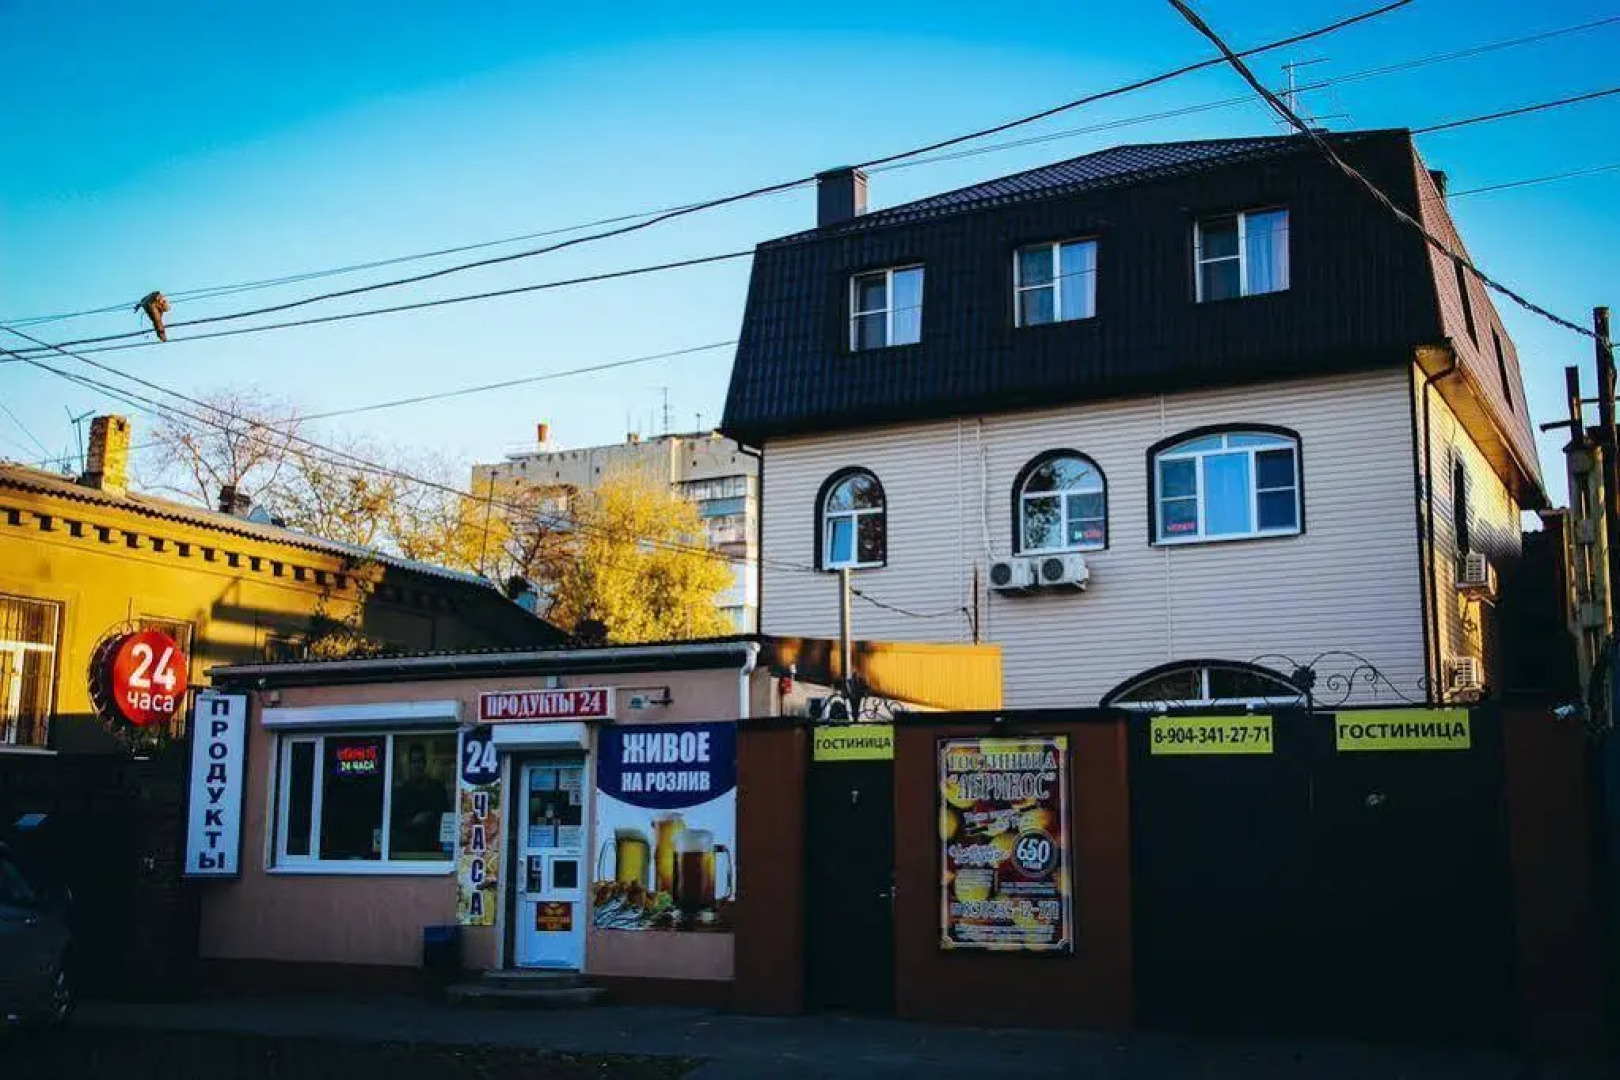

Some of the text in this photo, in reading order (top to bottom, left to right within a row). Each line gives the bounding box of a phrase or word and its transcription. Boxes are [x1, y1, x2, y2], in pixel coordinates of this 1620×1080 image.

[128, 642, 177, 691] 24
[127, 691, 174, 712] часа
[487, 691, 601, 717] ПРОДУКТЫ 24
[816, 736, 892, 750] ГОСТИНИЦА
[1154, 726, 1270, 744] 8-904-341-27-71
[1338, 721, 1466, 741] ГОСТИНИЦА
[466, 740, 498, 774] 24
[622, 731, 711, 764] ЖИВОЕ
[198, 699, 227, 869] ПРОДУКТЫ
[621, 771, 711, 792] НА РОЗЛИВ
[470, 792, 488, 916] ЧАСА
[1016, 838, 1051, 863] 650
